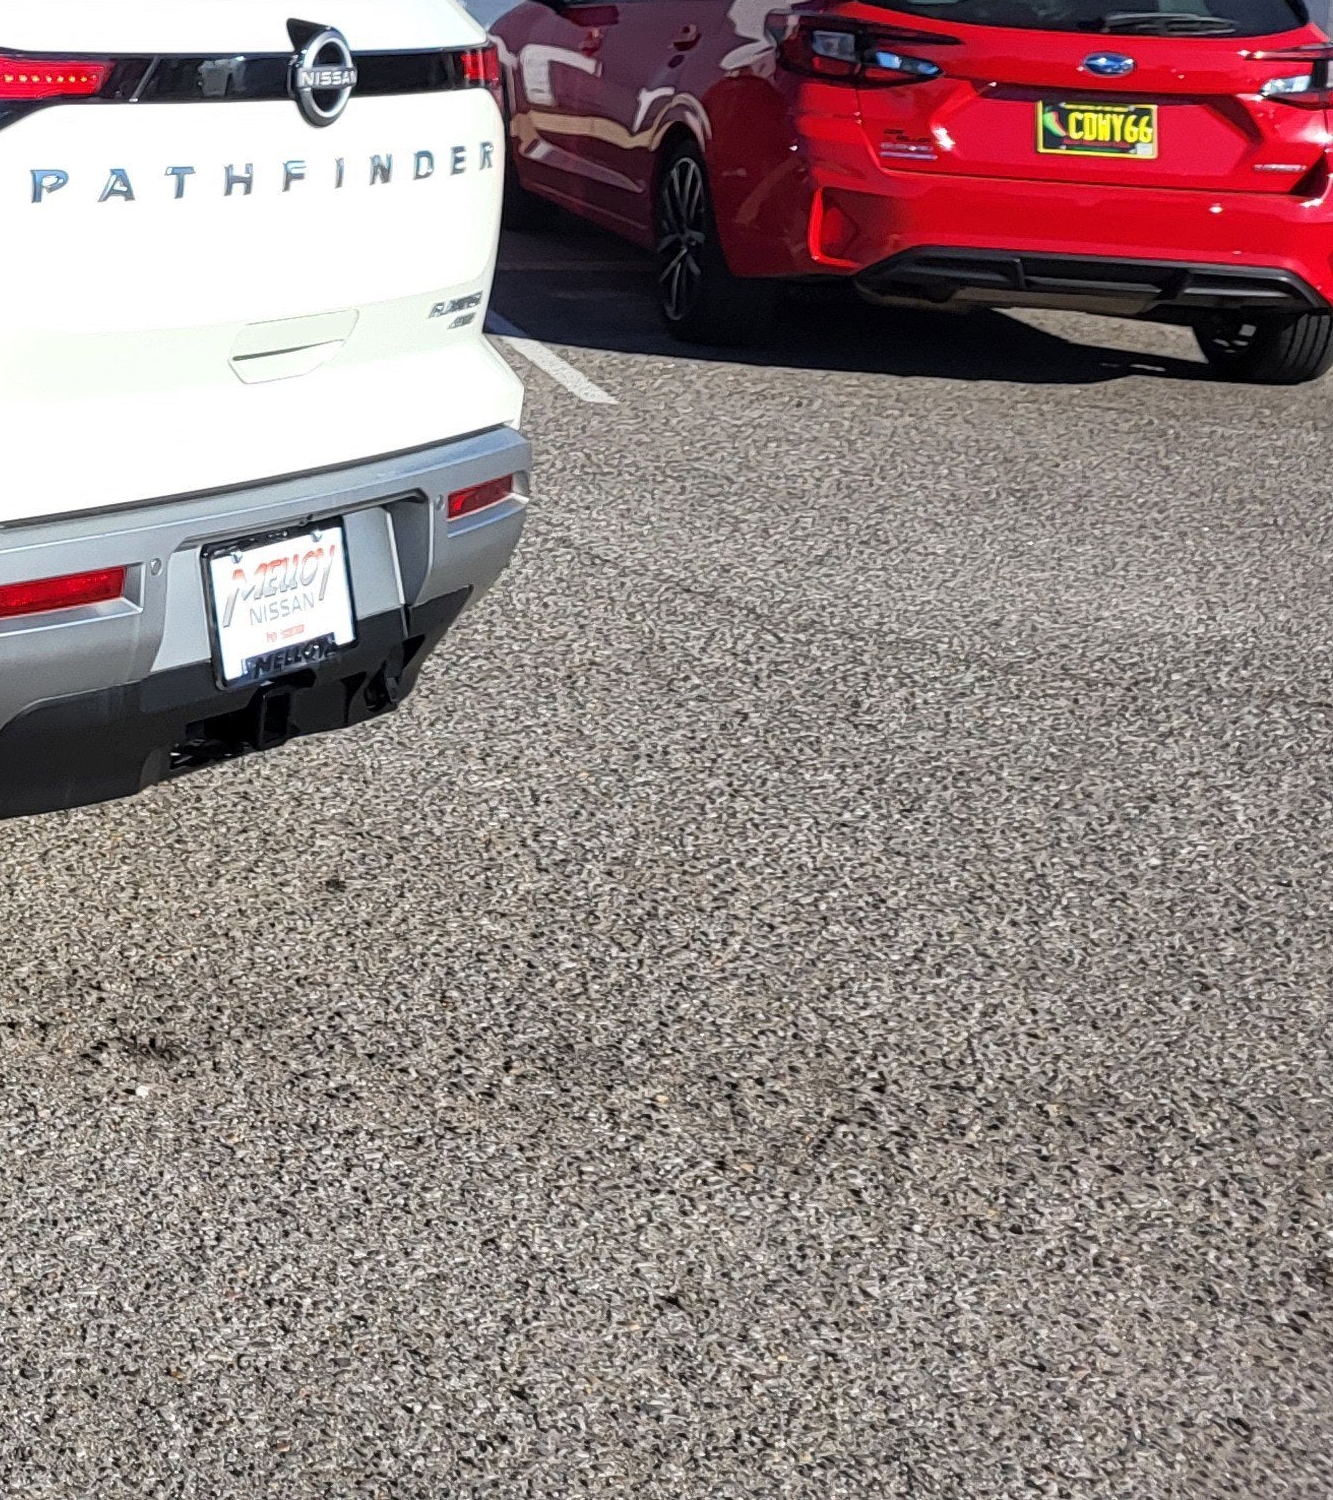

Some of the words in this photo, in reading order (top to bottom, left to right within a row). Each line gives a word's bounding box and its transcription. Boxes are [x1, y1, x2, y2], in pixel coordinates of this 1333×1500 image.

[299, 70, 357, 87] NISSAN
[30, 140, 496, 204] PATHFINDER
[249, 591, 315, 626] NISSAN
